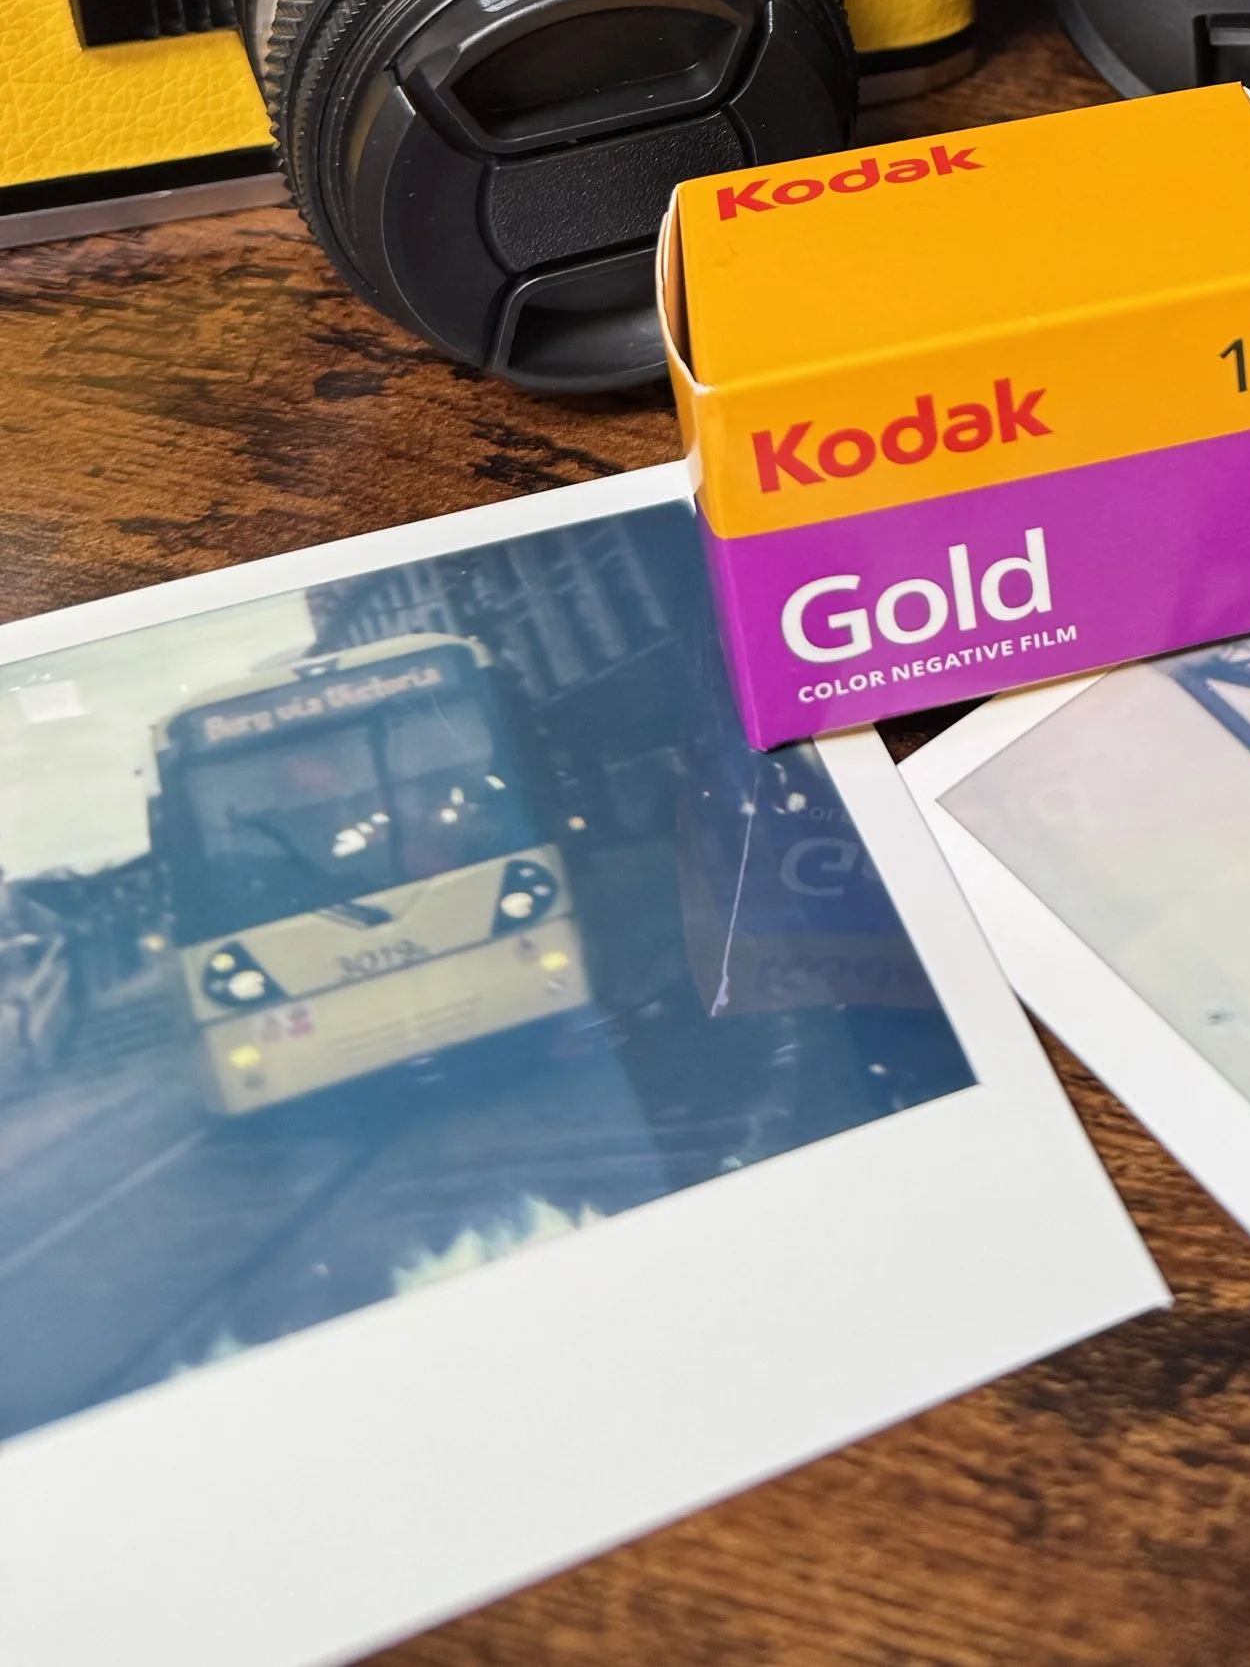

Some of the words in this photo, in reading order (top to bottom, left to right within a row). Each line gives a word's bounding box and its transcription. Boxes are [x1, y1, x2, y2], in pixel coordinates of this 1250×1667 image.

[717, 144, 987, 222] Kodak
[1219, 337, 1248, 393] 1
[751, 377, 1055, 494] Kodak
[781, 527, 1053, 664] Gold
[798, 669, 886, 704] COLOR
[891, 638, 1014, 684] NEGATIVE
[1019, 624, 1078, 652] FILM
